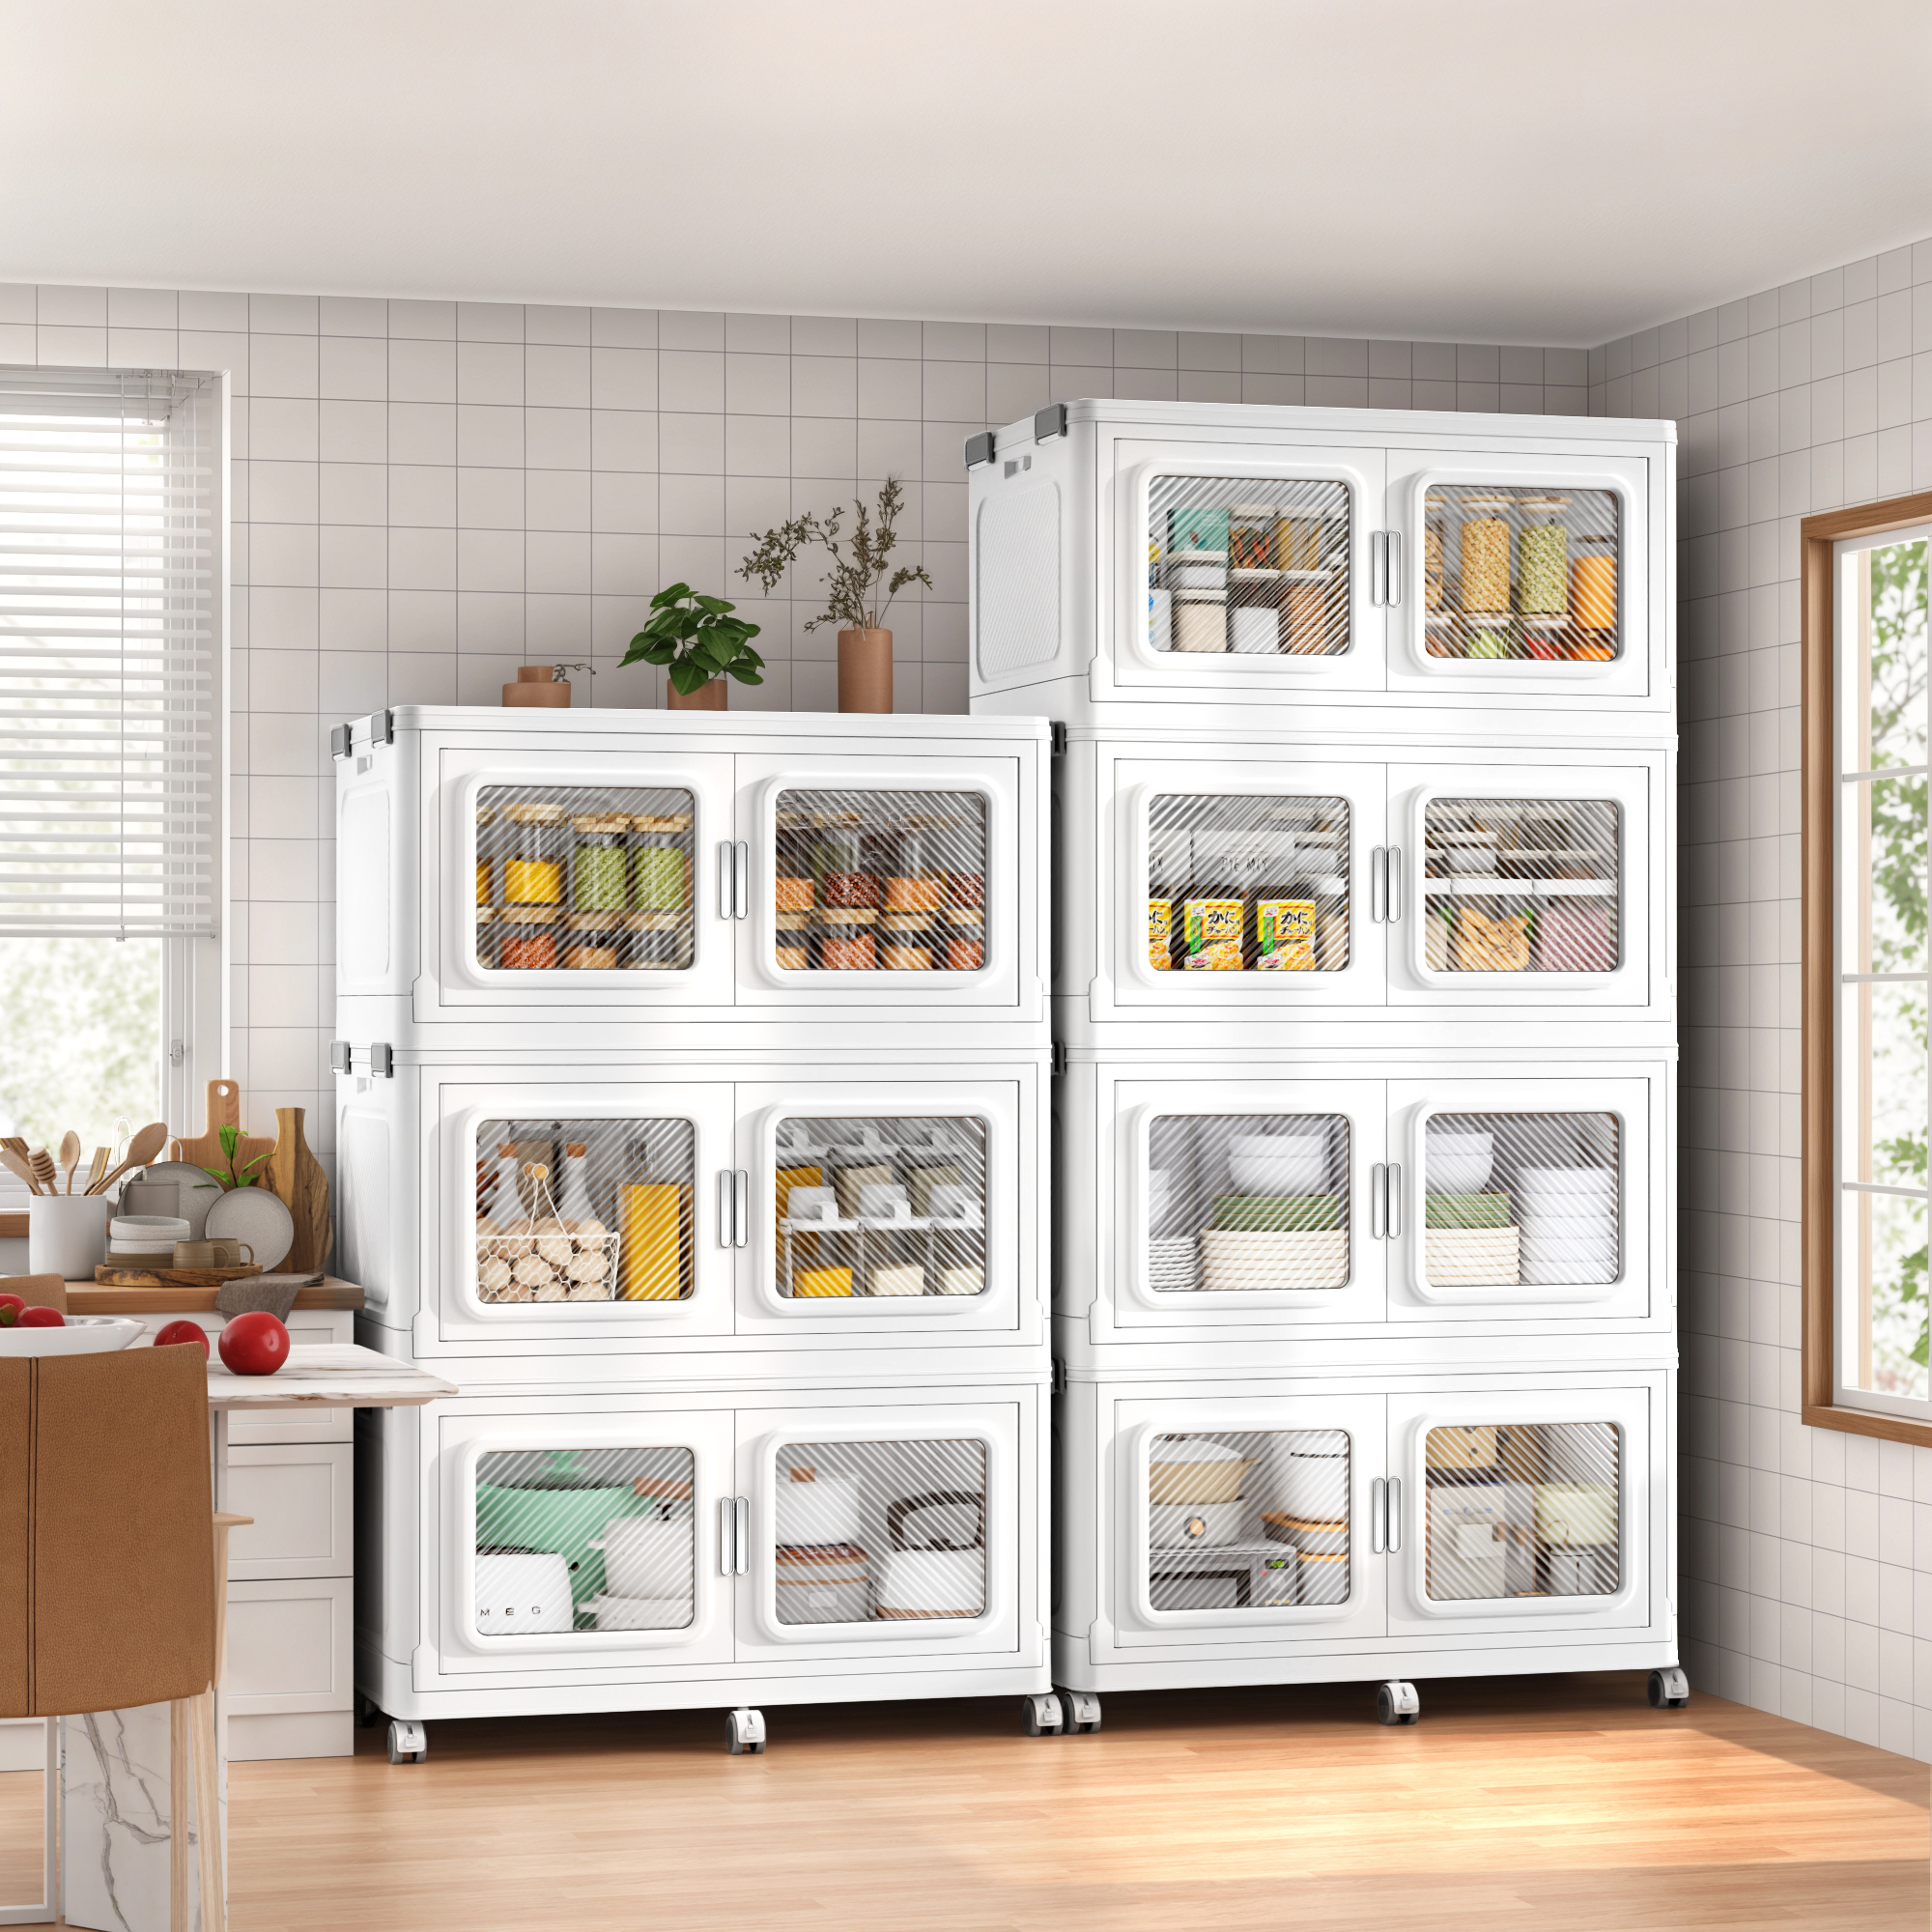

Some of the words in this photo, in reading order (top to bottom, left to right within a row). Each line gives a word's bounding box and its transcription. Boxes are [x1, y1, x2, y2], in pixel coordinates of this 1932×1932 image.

[1208, 910, 1236, 924] かに
[1280, 911, 1308, 924] かに
[480, 1605, 541, 1616] MEG
